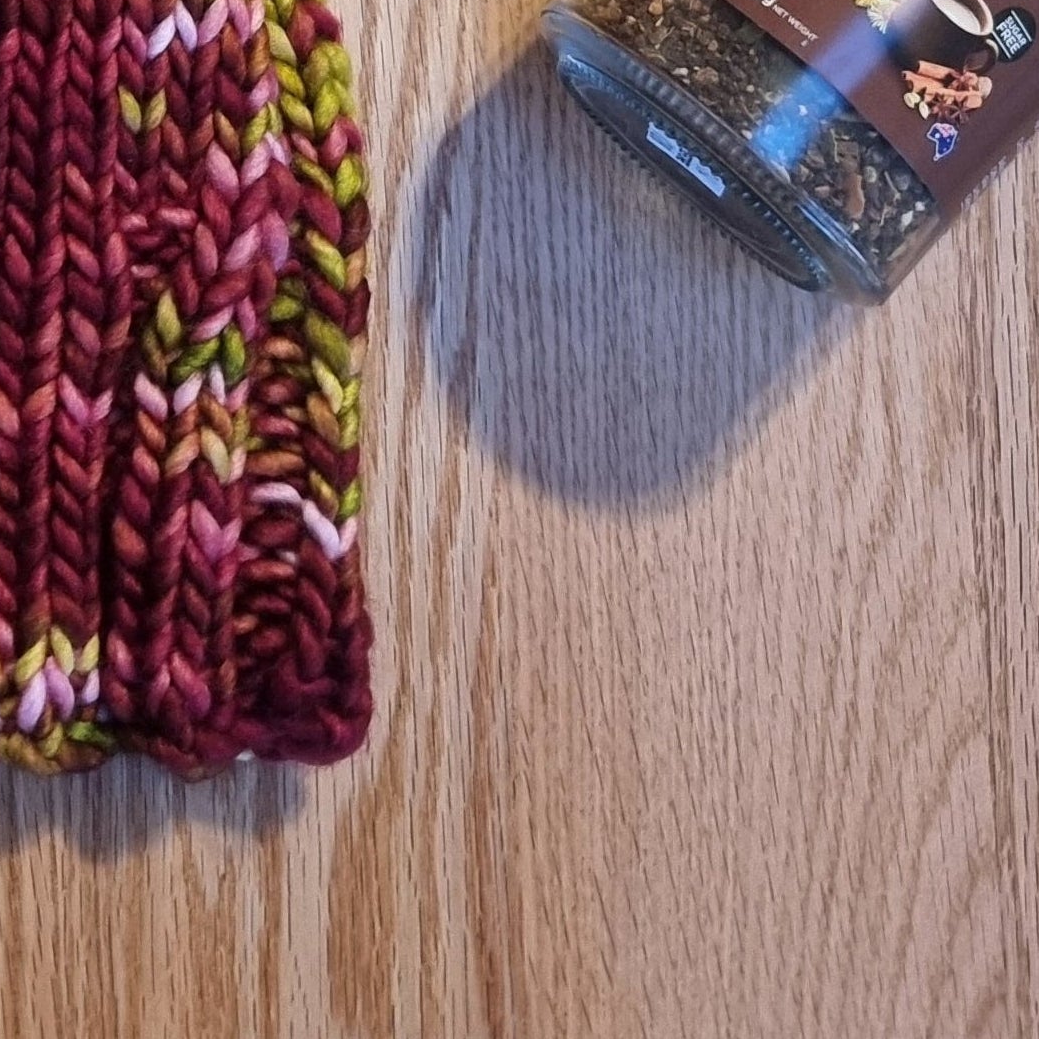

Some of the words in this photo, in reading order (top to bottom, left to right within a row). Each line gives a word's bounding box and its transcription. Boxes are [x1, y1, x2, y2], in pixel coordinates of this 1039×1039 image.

[772, 3, 790, 19] NET
[787, 13, 819, 42] WEIGHT
[995, 21, 1021, 55] FREE
[1004, 15, 1027, 47] SUGAR
